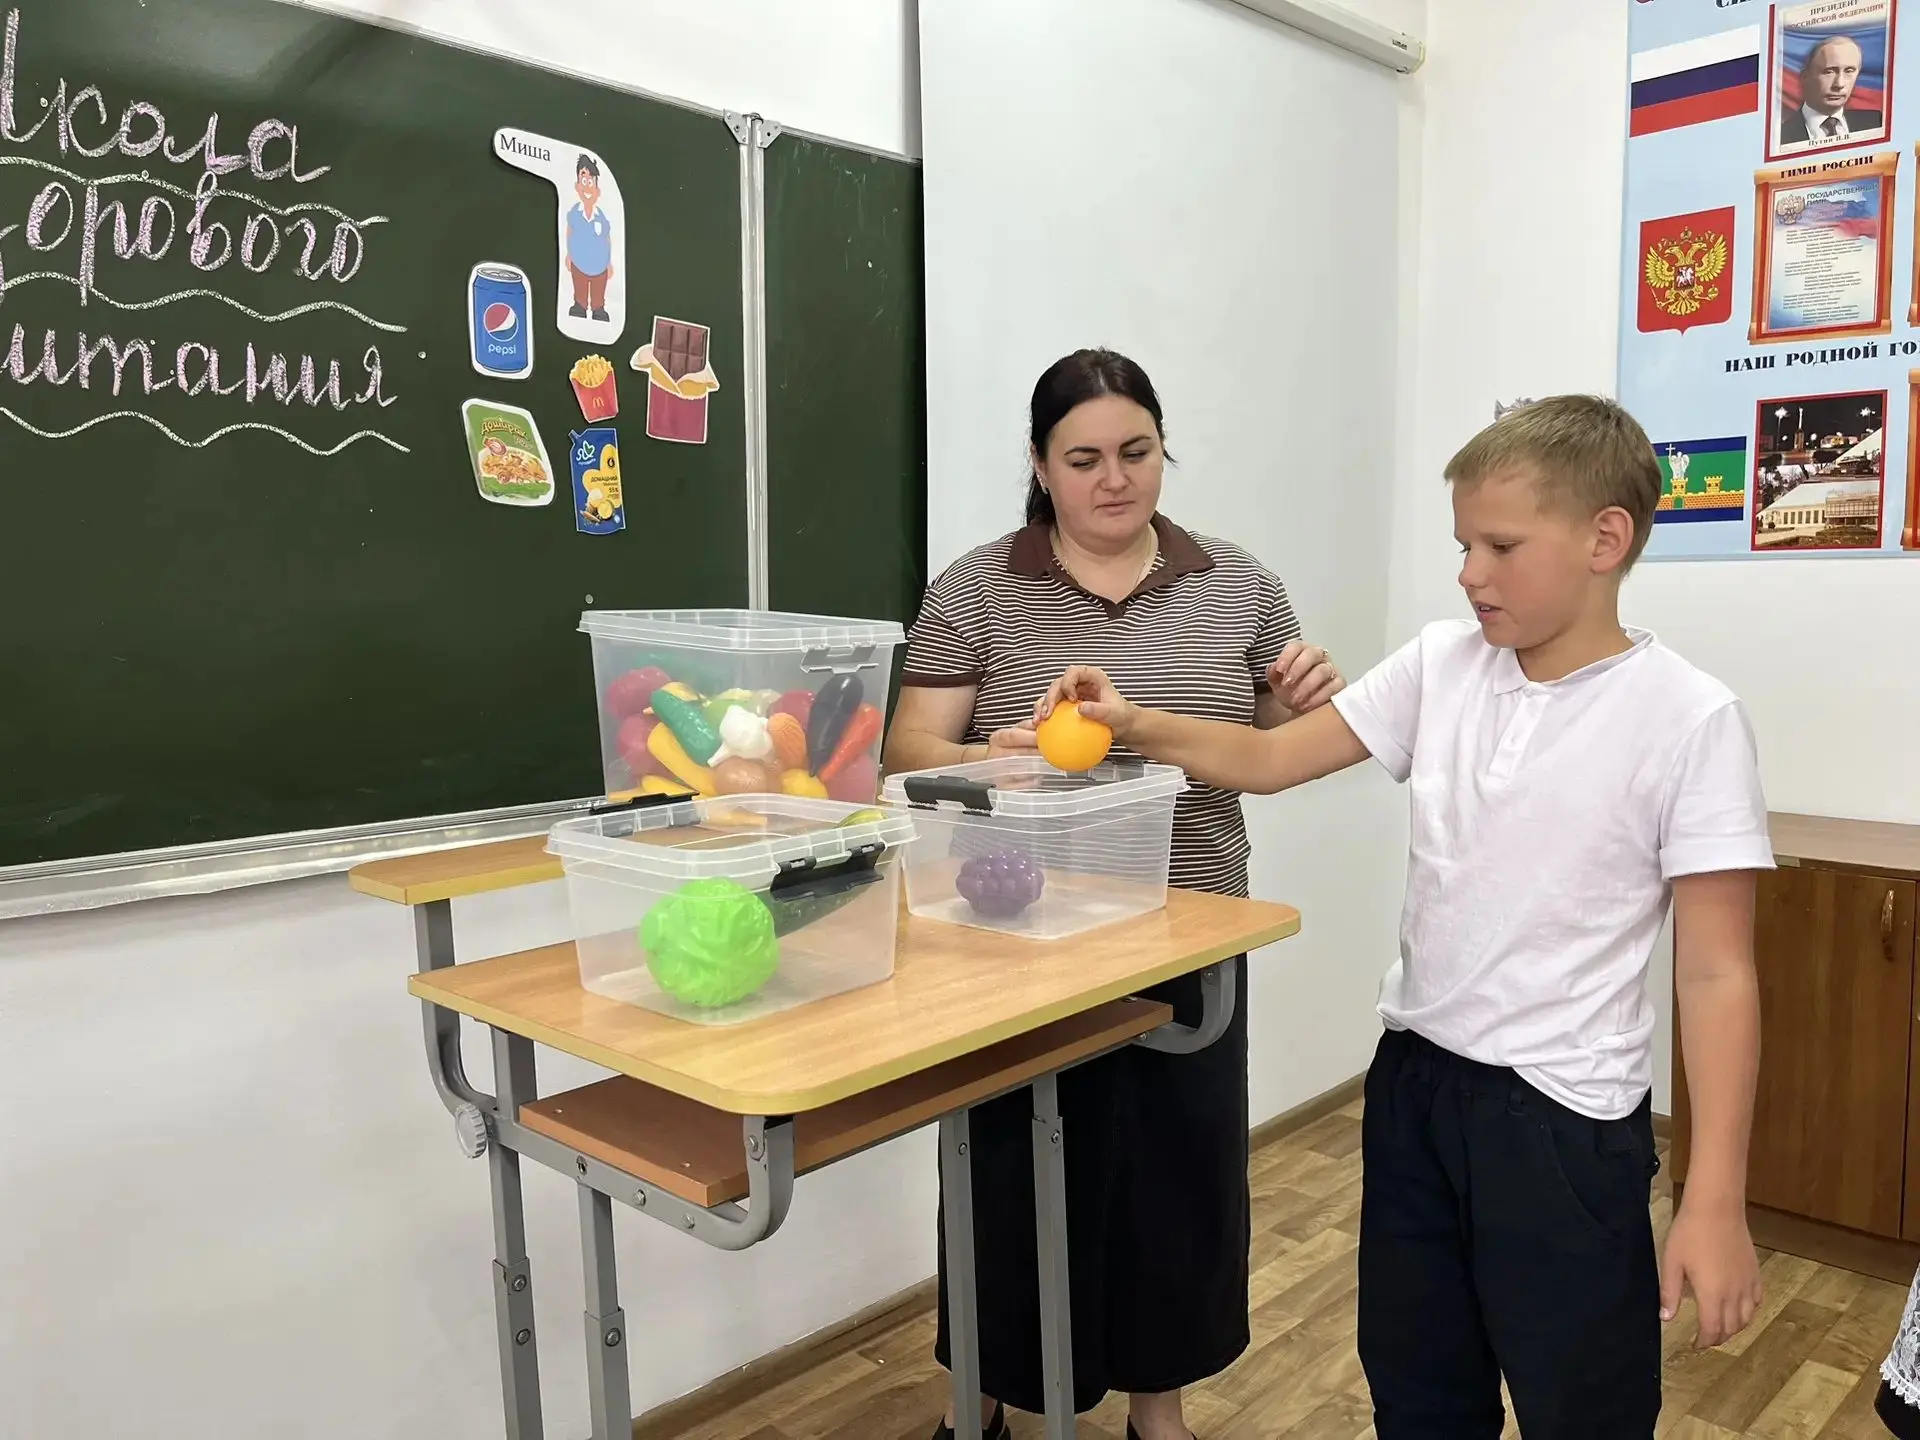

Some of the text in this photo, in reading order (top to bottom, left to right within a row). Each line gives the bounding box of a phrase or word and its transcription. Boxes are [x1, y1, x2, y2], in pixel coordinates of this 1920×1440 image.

[0, 8, 331, 182] кола
[500, 133, 551, 161] Миша
[1780, 155, 1873, 178] ГИМН РОССИИ
[0, 171, 364, 306] орового
[488, 344, 517, 356] pepsi
[1725, 341, 1920, 372] НАШ РОДНОЙ ГО
[0, 322, 398, 411] итания
